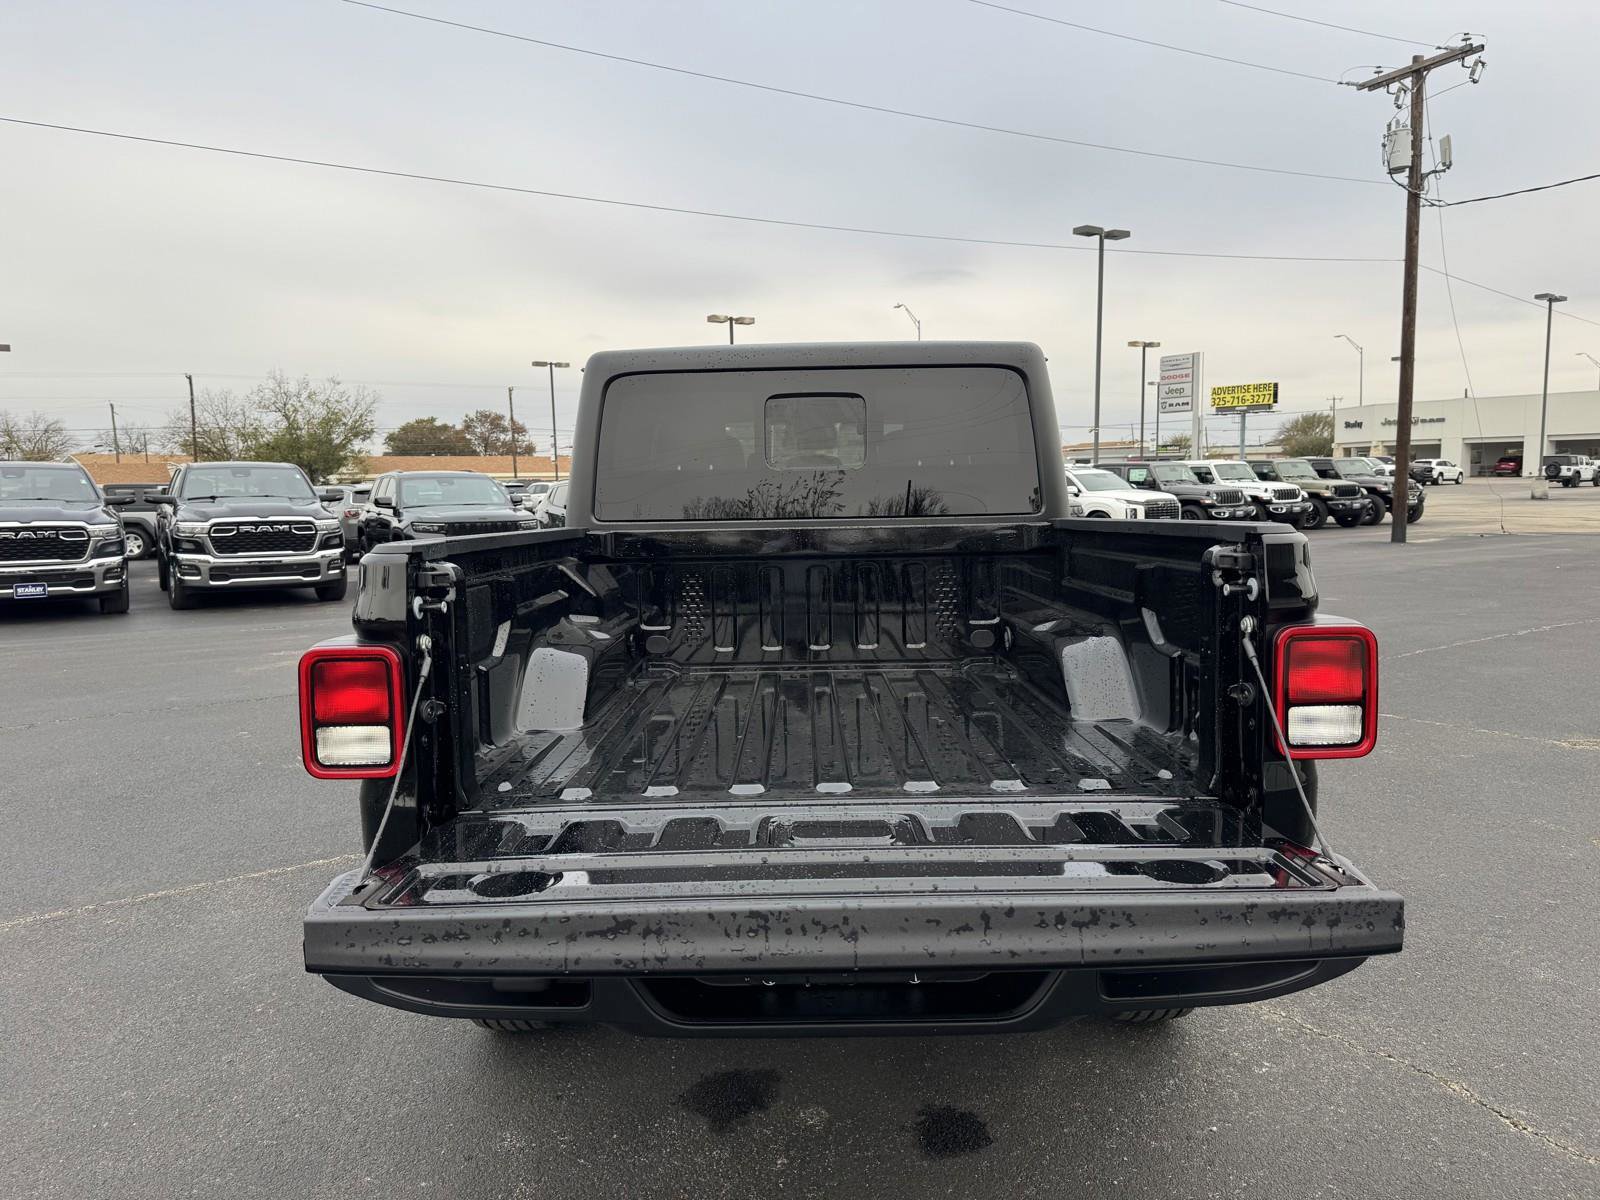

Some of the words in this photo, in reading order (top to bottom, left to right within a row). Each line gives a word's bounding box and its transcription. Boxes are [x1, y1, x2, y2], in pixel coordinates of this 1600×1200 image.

[1161, 373, 1190, 381] DODGE
[1165, 387, 1185, 396] Jeep
[1211, 385, 1252, 396] ADVERTISE
[1253, 383, 1272, 392] HERE
[1211, 393, 1272, 407] 325-716-3277
[239, 525, 290, 533] RAM
[0, 531, 57, 539] RAM
